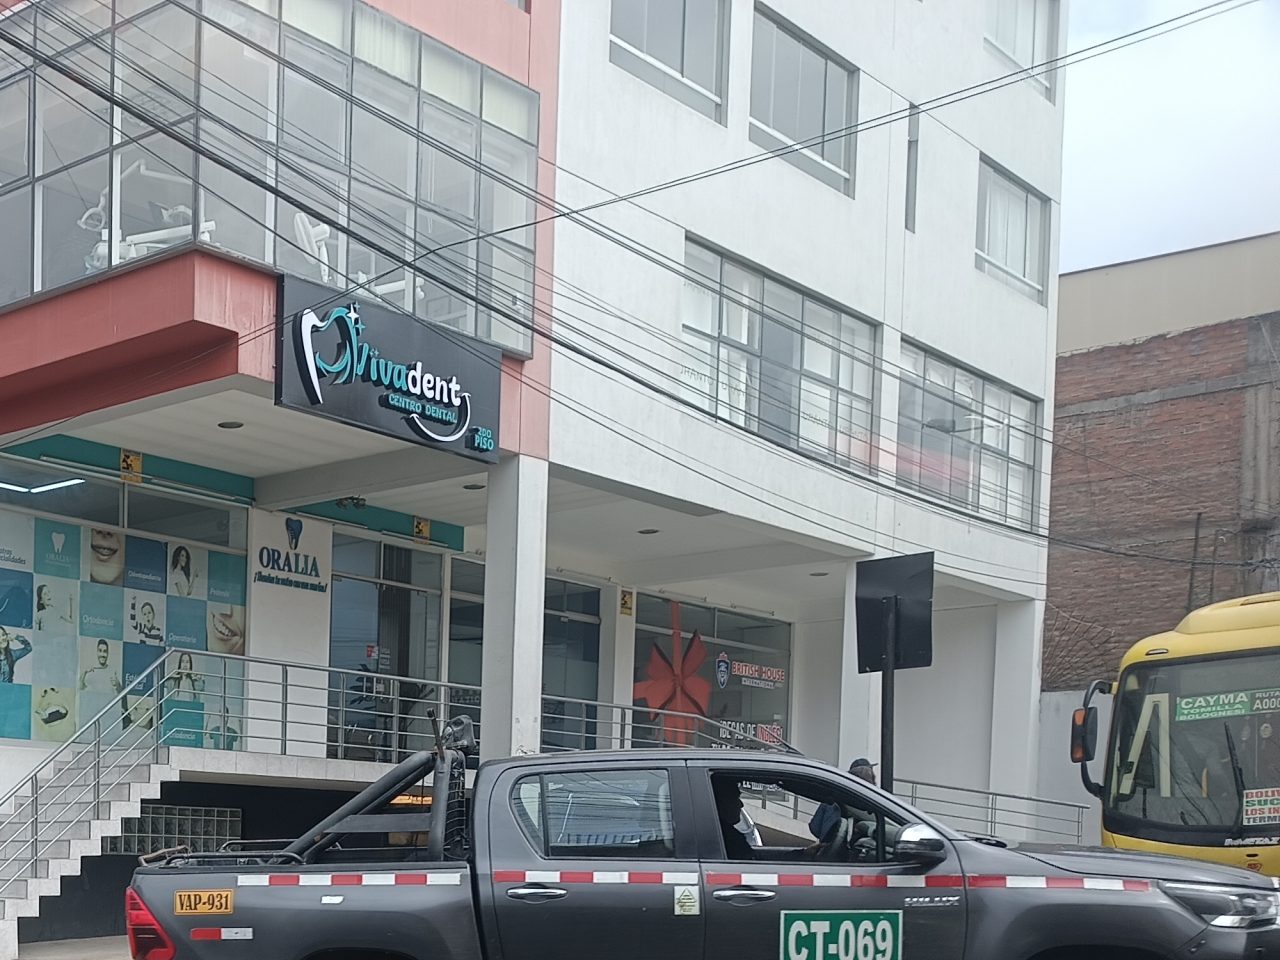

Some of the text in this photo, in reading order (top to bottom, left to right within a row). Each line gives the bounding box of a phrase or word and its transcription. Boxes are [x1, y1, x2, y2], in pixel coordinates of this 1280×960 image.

[389, 393, 458, 424] CENTRO DENTAL
[477, 426, 492, 438] 2DO
[475, 436, 494, 451] PISO
[259, 546, 321, 577] ORALIA
[732, 661, 785, 682] BRITISH HOUSE
[1181, 692, 1249, 709] CAYMA
[1182, 703, 1243, 714] TOMILLA
[1180, 709, 1245, 721] BOLOGNESI
[1245, 807, 1264, 817] LOS
[178, 893, 230, 911] VAP-931
